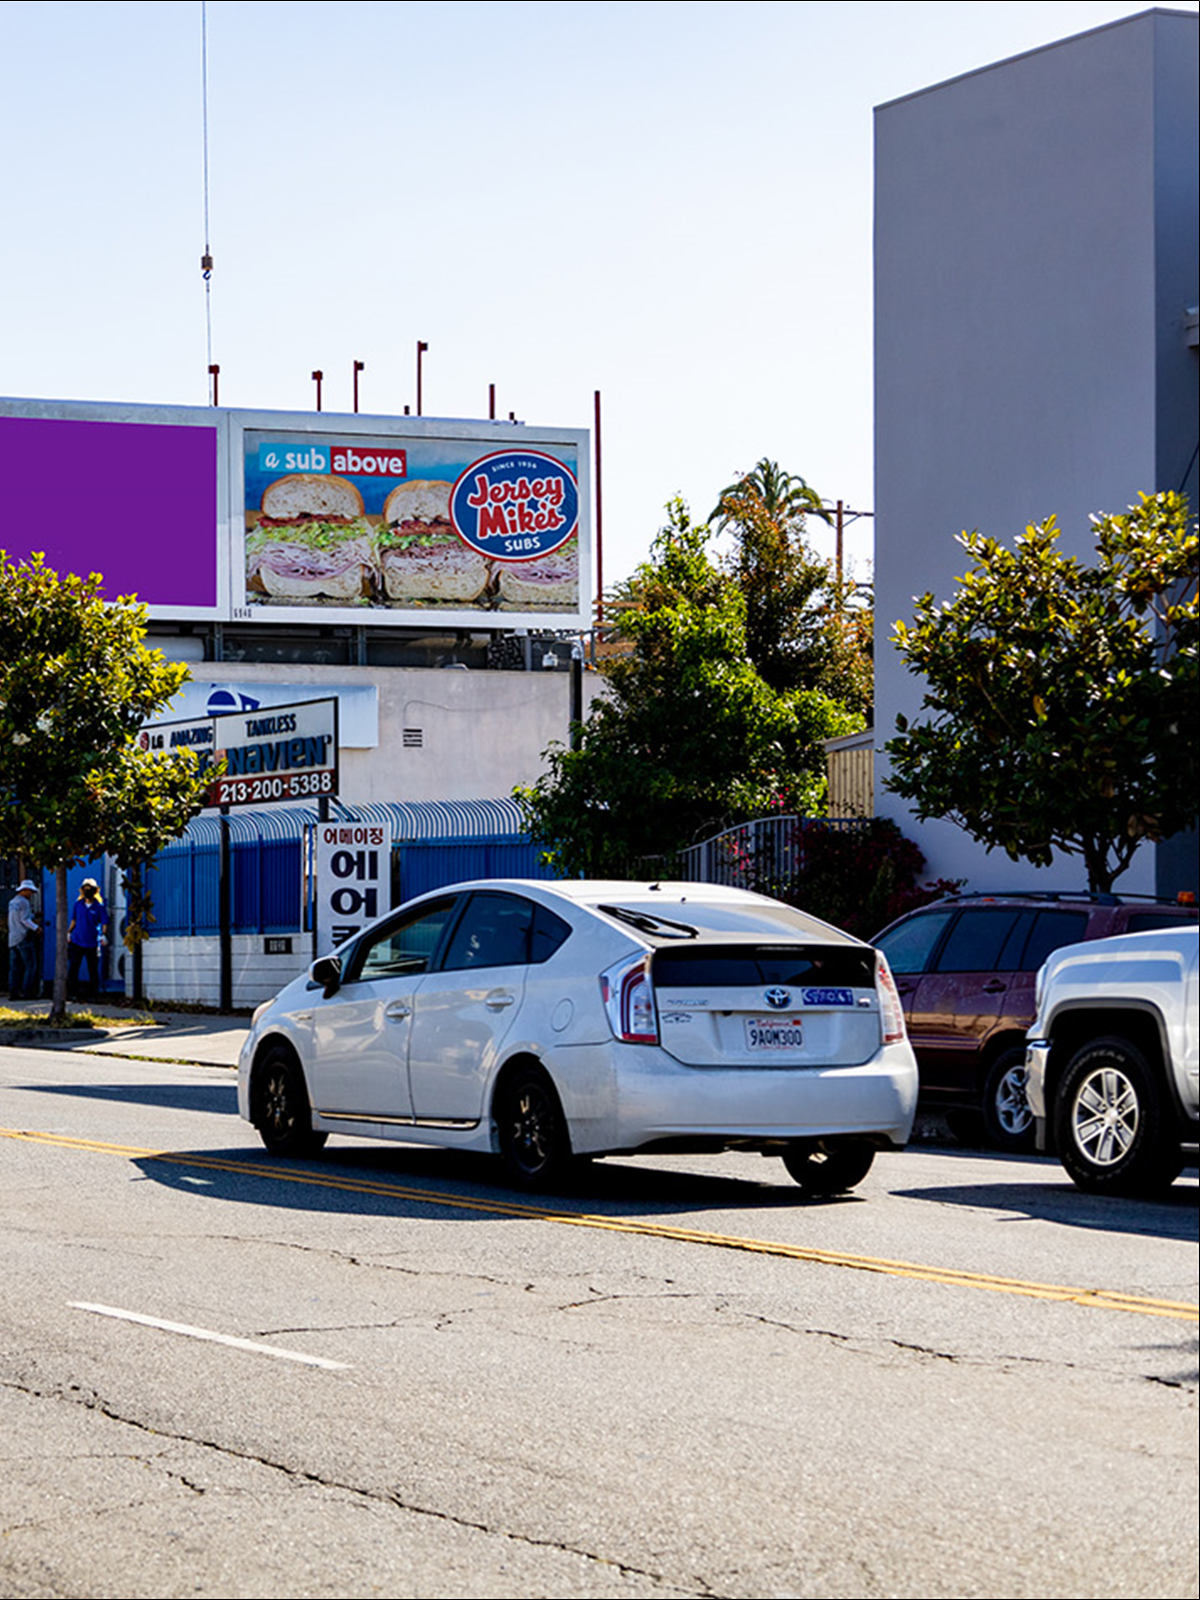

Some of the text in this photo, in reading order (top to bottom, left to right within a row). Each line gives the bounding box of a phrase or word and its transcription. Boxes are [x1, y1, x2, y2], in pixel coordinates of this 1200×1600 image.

[265, 448, 404, 474] a sub above
[492, 461, 515, 472] SINCE
[468, 474, 564, 508] Jersey
[478, 501, 565, 539] Mike's
[504, 536, 541, 552] SUBS
[245, 714, 296, 737] TANKLESS
[151, 726, 213, 749] LG AMAZING
[323, 828, 383, 845] 어메이징
